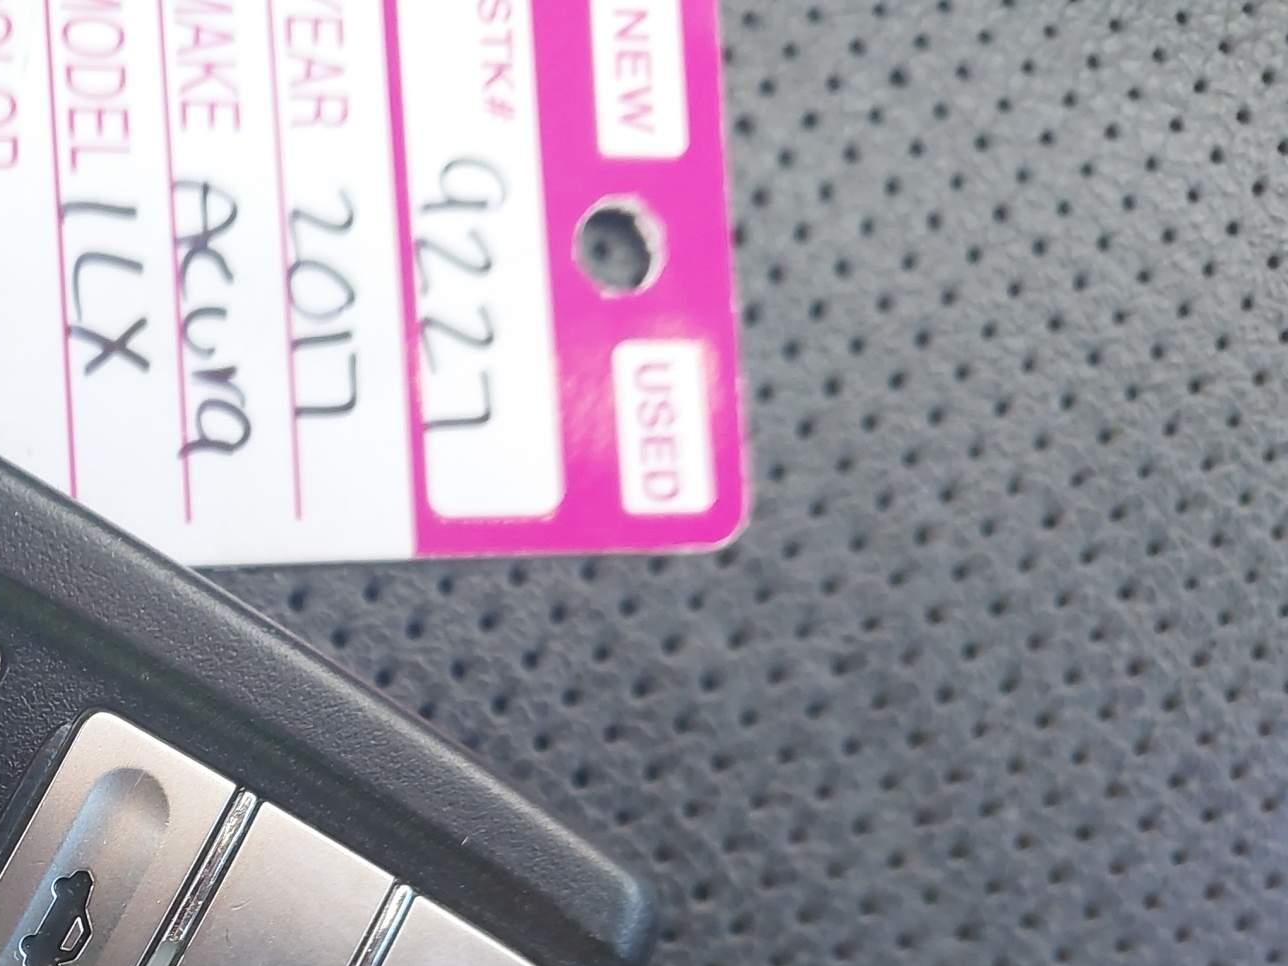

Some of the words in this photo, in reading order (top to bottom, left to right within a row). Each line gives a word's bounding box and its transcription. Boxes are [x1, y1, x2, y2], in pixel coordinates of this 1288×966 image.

[62, 0, 132, 174] ODEL
[476, 0, 516, 123] STK#
[613, 9, 654, 135] NEW
[172, 180, 253, 458] Acura
[288, 188, 358, 417] 2017
[414, 157, 507, 432] 9227
[634, 361, 681, 503] USED
